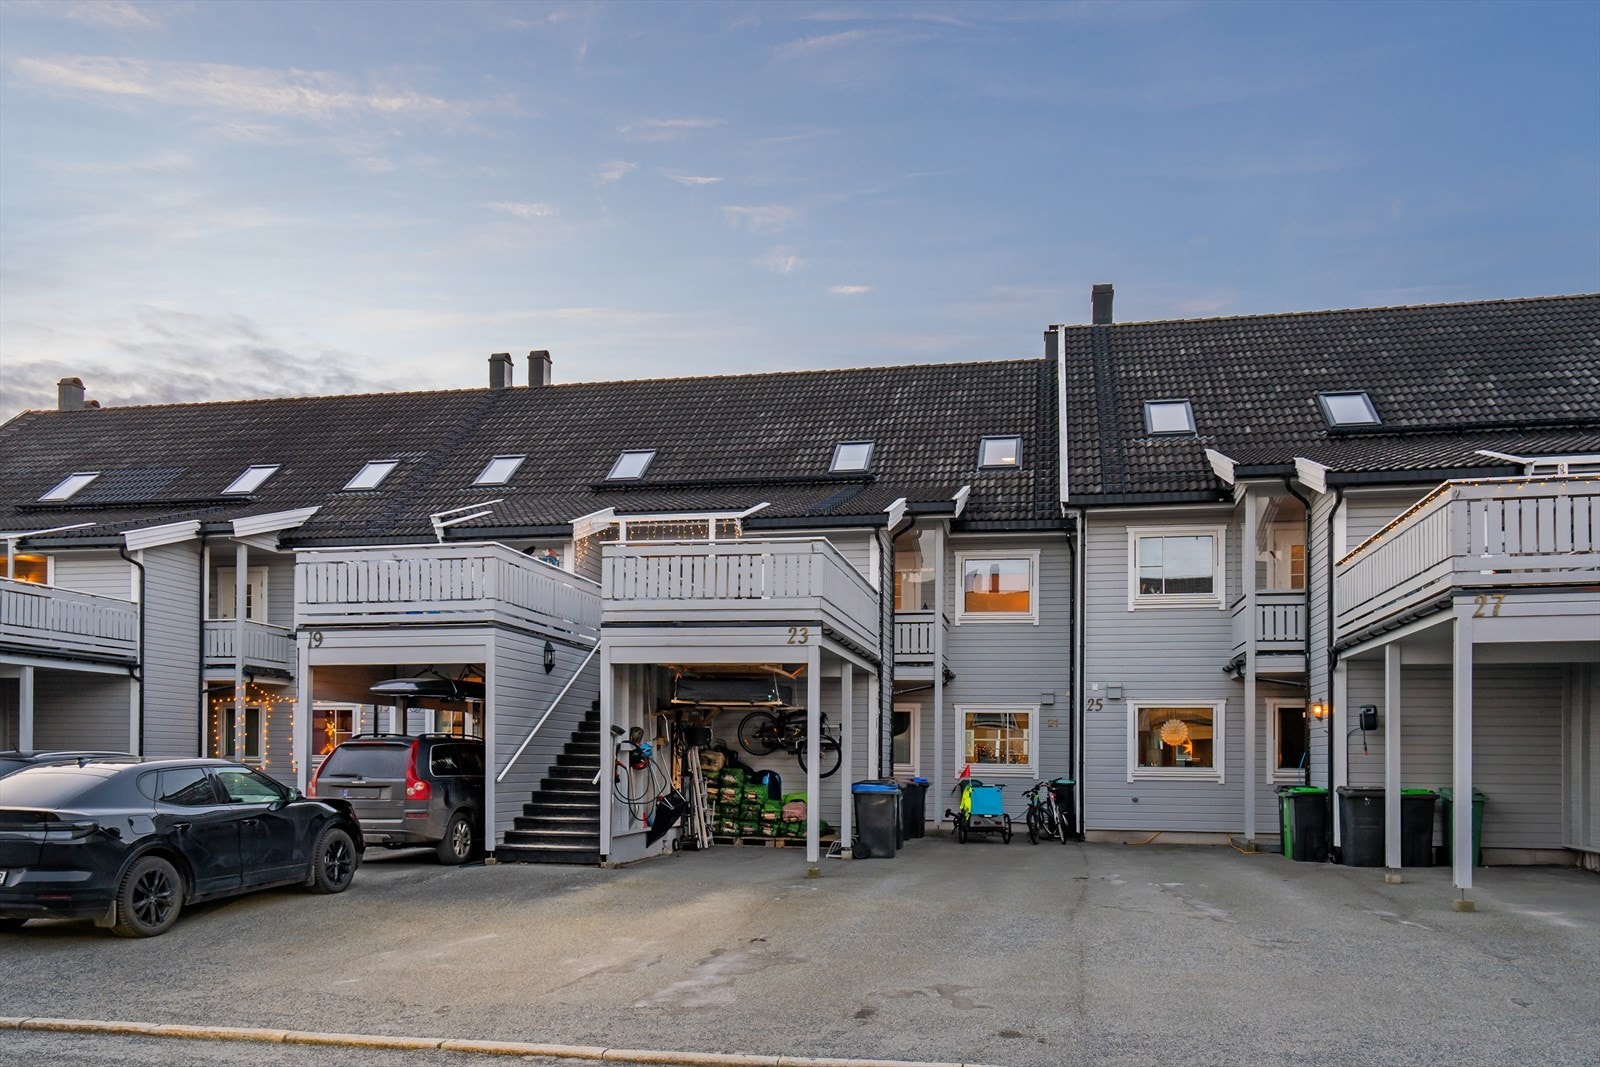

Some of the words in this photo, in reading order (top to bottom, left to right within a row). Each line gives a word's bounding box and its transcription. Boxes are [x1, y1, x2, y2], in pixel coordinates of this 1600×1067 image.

[1473, 593, 1505, 617] 27
[308, 630, 323, 649] 19
[787, 625, 808, 644] 23
[1086, 698, 1103, 712] 25
[1047, 719, 1059, 728] 21
